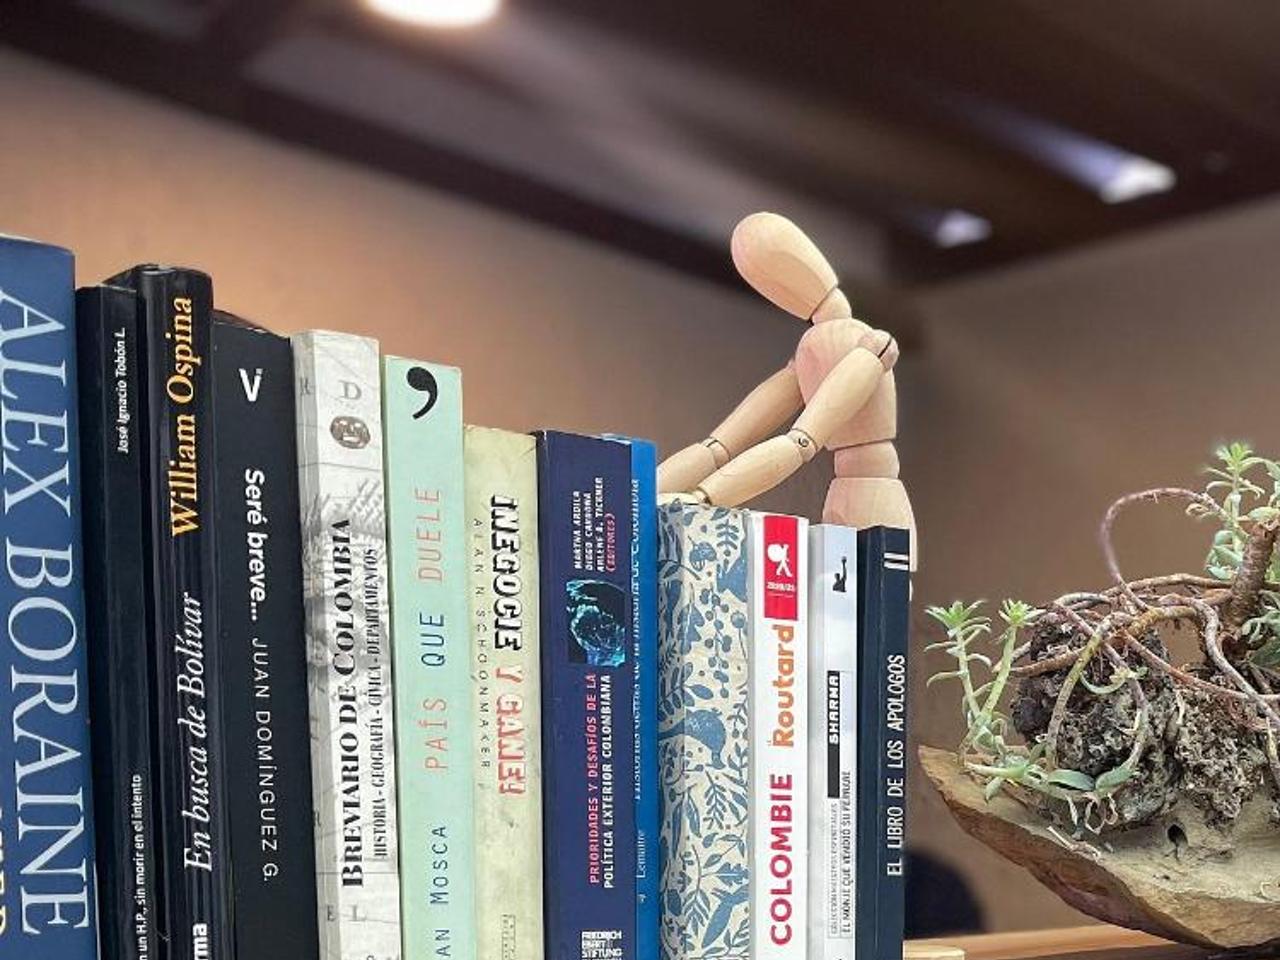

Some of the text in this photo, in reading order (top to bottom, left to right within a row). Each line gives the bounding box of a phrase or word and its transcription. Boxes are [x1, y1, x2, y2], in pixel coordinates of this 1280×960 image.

[116, 378, 130, 422] Ignacio
[166, 296, 201, 538] William Ospina
[245, 469, 268, 621] Seré breve...
[474, 518, 485, 573] ALAN
[0, 287, 90, 935] ALEX BORAINE
[363, 548, 382, 656] DEPARTAMENTOS
[415, 487, 448, 770] PAÍS QUE DUELE
[251, 638, 271, 698] JUAN
[331, 519, 364, 888] BREVIARIO DE COLOMBIA
[496, 664, 525, 683] Y
[770, 624, 794, 749] Routard
[828, 675, 839, 744] SHARMA
[175, 591, 213, 872] En busca de Bolívar
[364, 717, 386, 788] GEOGRAFÍA
[585, 673, 600, 883] PRIORIDADES Y DESAFÍOS DE LA
[887, 654, 905, 876] EL LIBRO DE LOS APOLOGOS
[130, 774, 143, 819] intento
[254, 711, 278, 852] DOMÍNGUEZ
[370, 797, 388, 858] HISTORIA
[600, 674, 614, 888] POLÍTICA EXTERIOR COLOMBIANA
[133, 852, 145, 885] morir
[134, 834, 145, 849] en
[430, 826, 449, 905] MOSCA
[769, 774, 793, 946] COLOMBIE
[134, 887, 147, 906] sin
[138, 937, 148, 952] un
